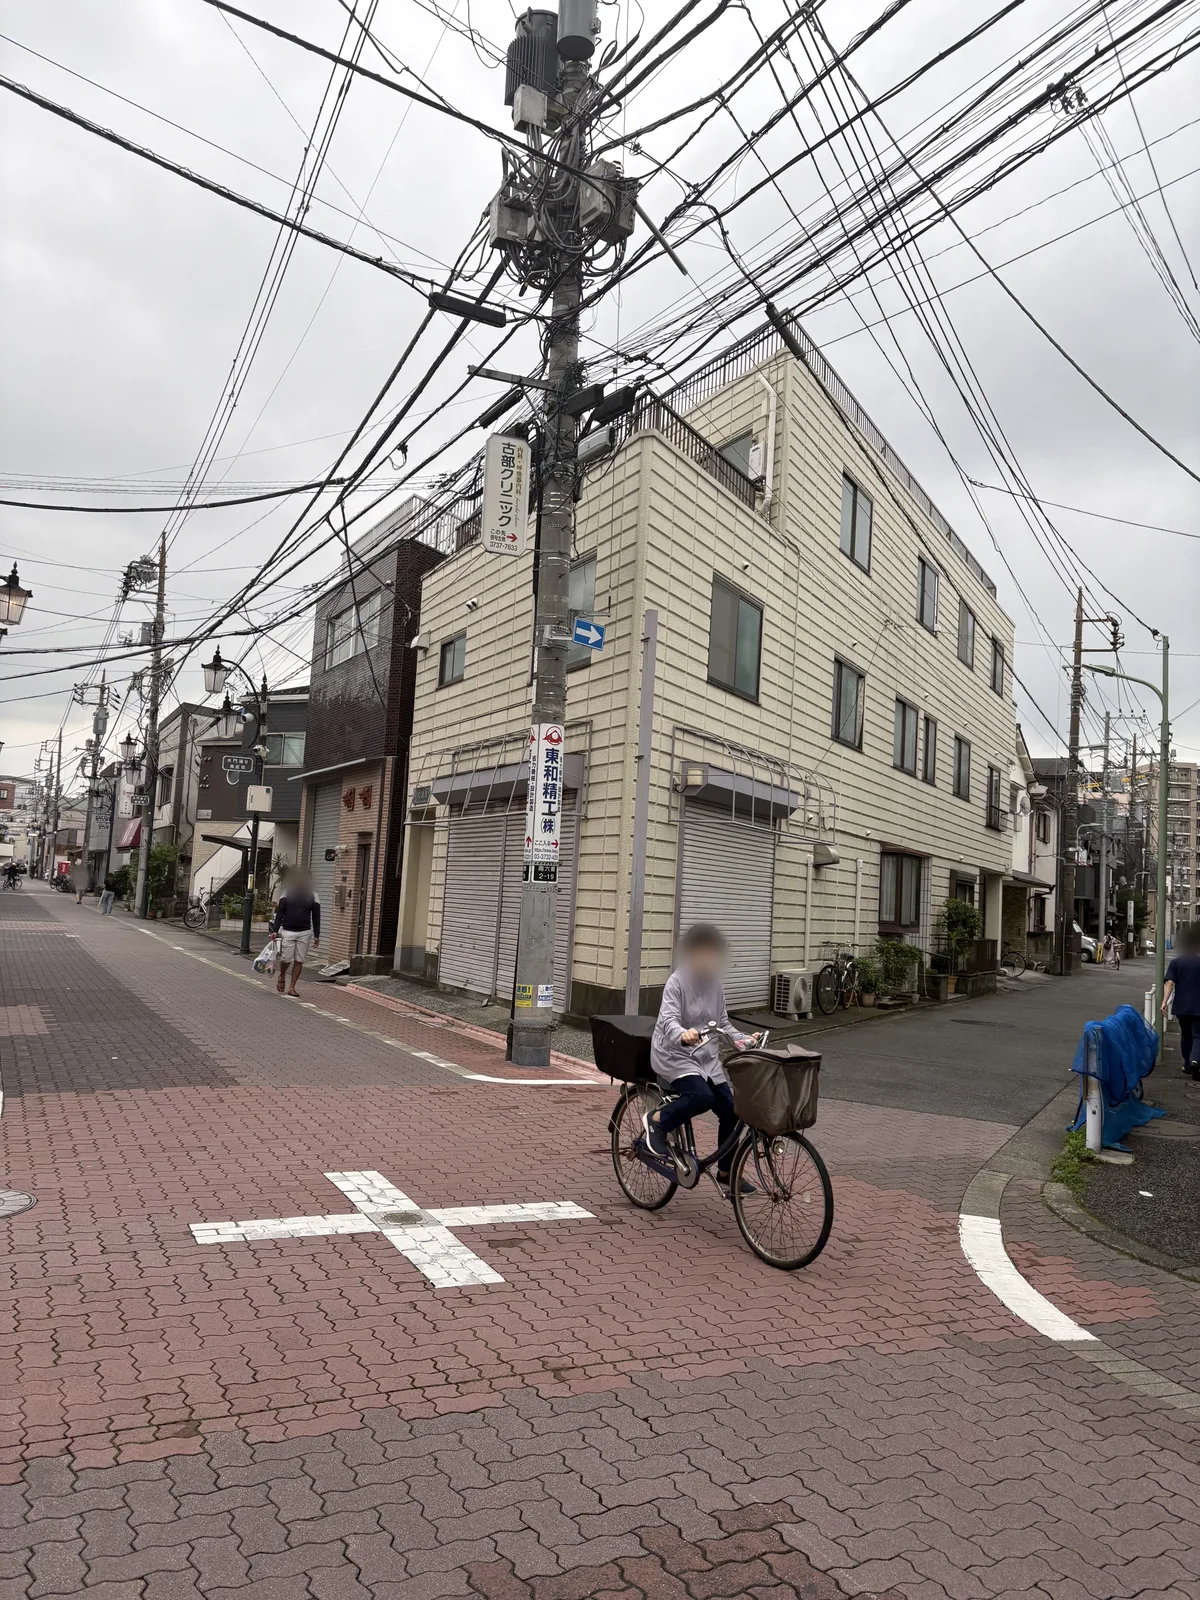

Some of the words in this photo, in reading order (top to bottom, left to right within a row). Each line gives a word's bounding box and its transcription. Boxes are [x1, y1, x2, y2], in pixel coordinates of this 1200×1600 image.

[498, 442, 516, 527] 古部クリニック
[490, 528, 506, 536] この先
